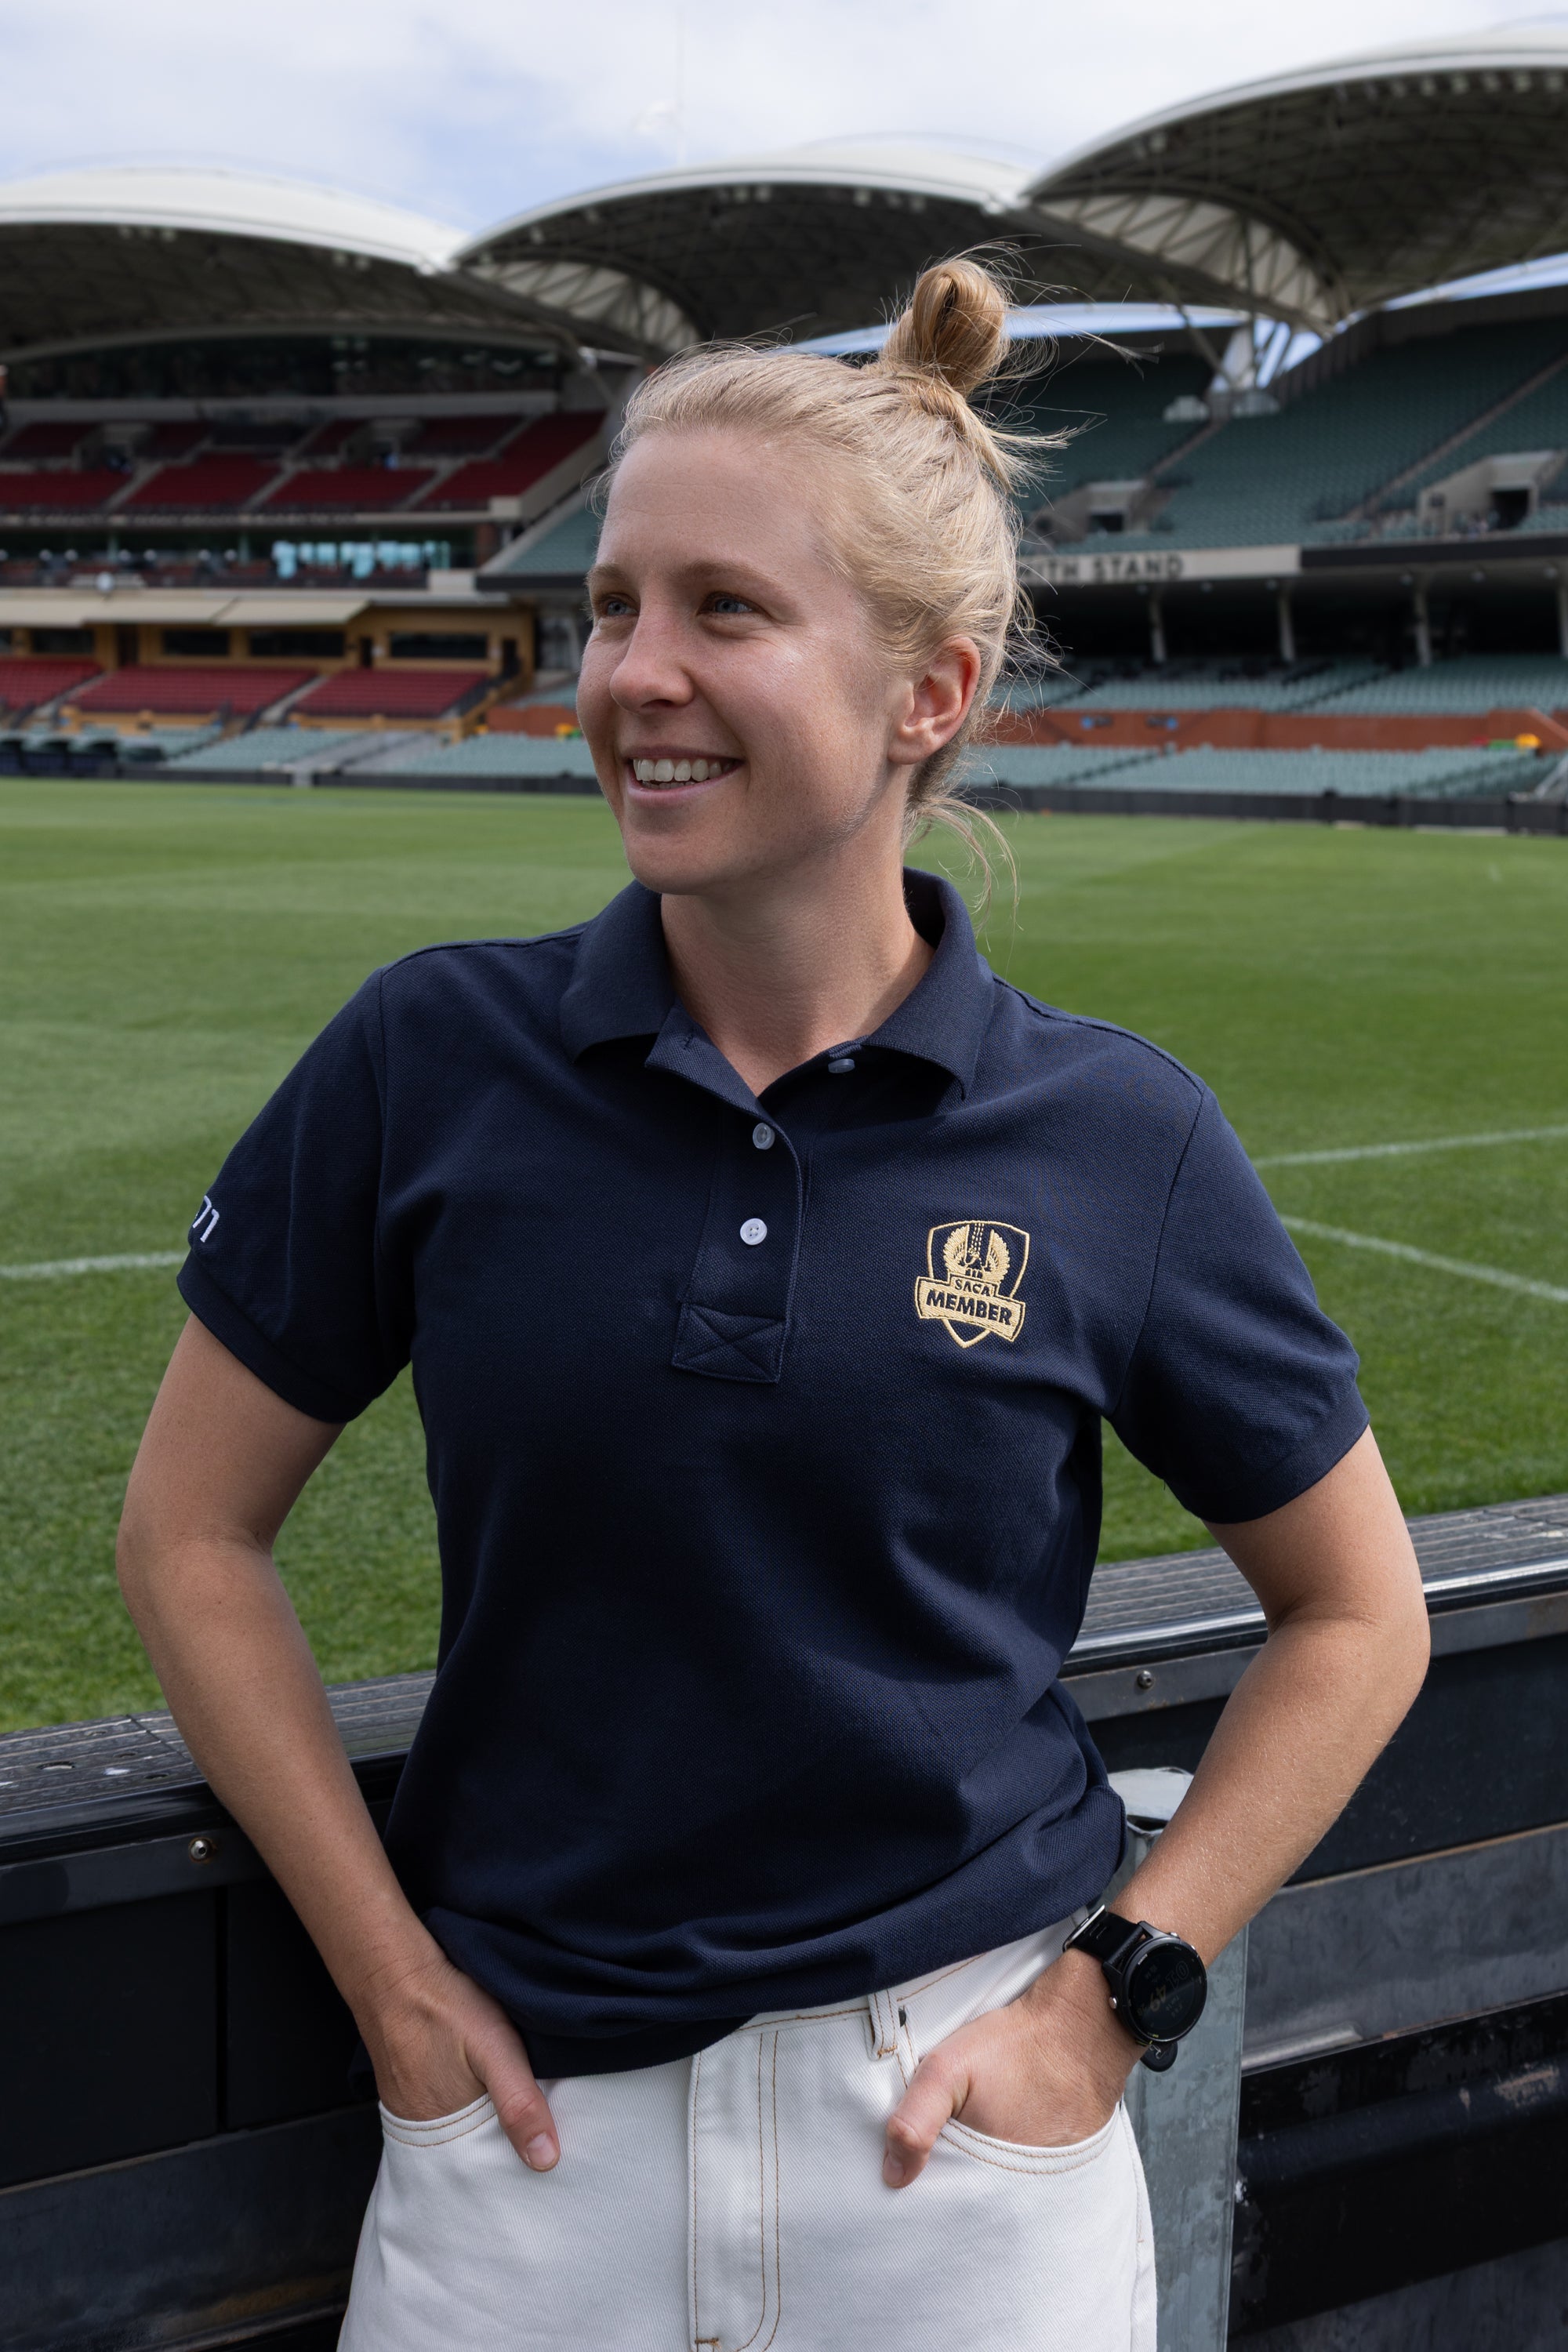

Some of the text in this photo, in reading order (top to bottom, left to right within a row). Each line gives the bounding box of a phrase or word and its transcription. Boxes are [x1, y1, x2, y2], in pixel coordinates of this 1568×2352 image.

[1026, 552, 1184, 582] TH STAND
[955, 1279, 989, 1296] SACA
[926, 1289, 1012, 1325] MEMBER
